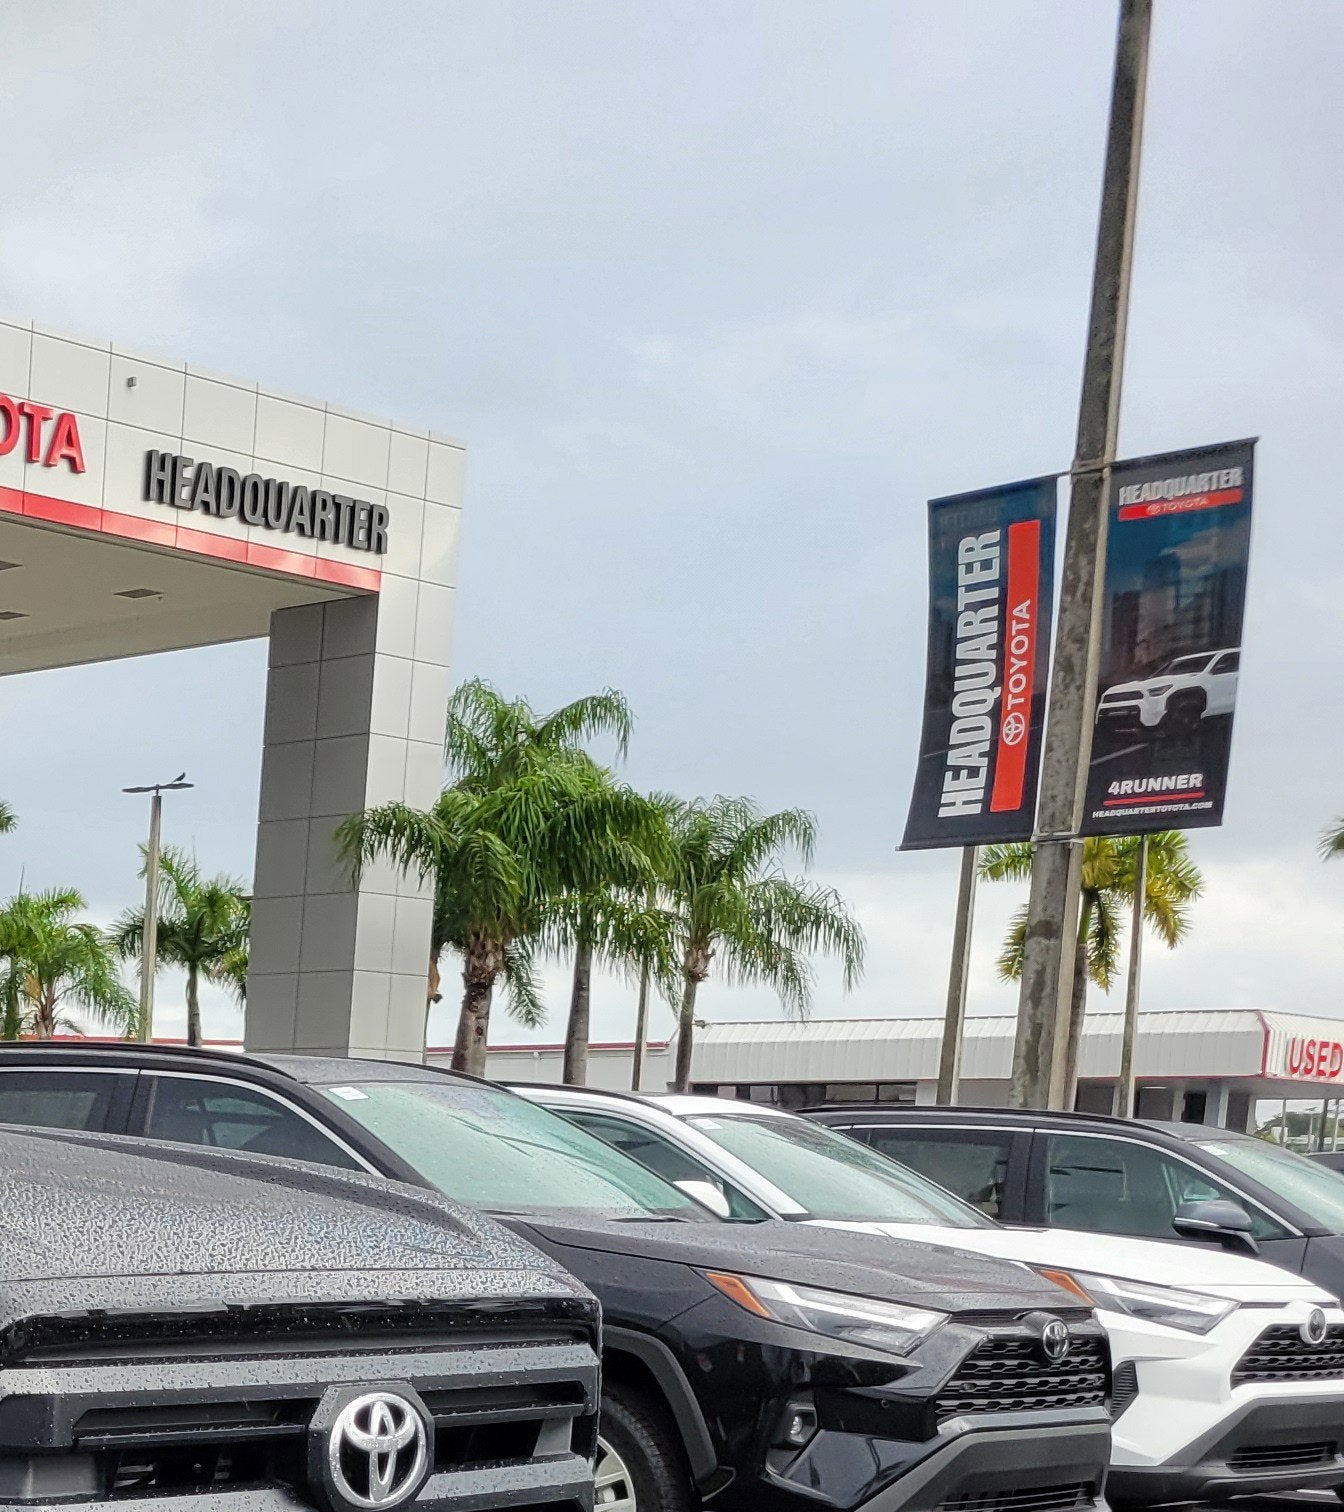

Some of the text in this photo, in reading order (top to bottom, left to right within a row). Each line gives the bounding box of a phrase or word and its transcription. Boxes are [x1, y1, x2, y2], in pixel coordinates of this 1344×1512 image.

[143, 448, 390, 555] HEADQUARTER
[1118, 466, 1244, 506] HEADQUARTER
[1162, 497, 1209, 514] TOYOTA
[937, 528, 1002, 818] HEADQUARTER
[1006, 599, 1032, 711] TOYOTA
[1107, 773, 1204, 796] 4RUNNER
[1092, 801, 1214, 819] HEADQUARTERTOYOTA.COM
[1289, 1037, 1343, 1078] USED
